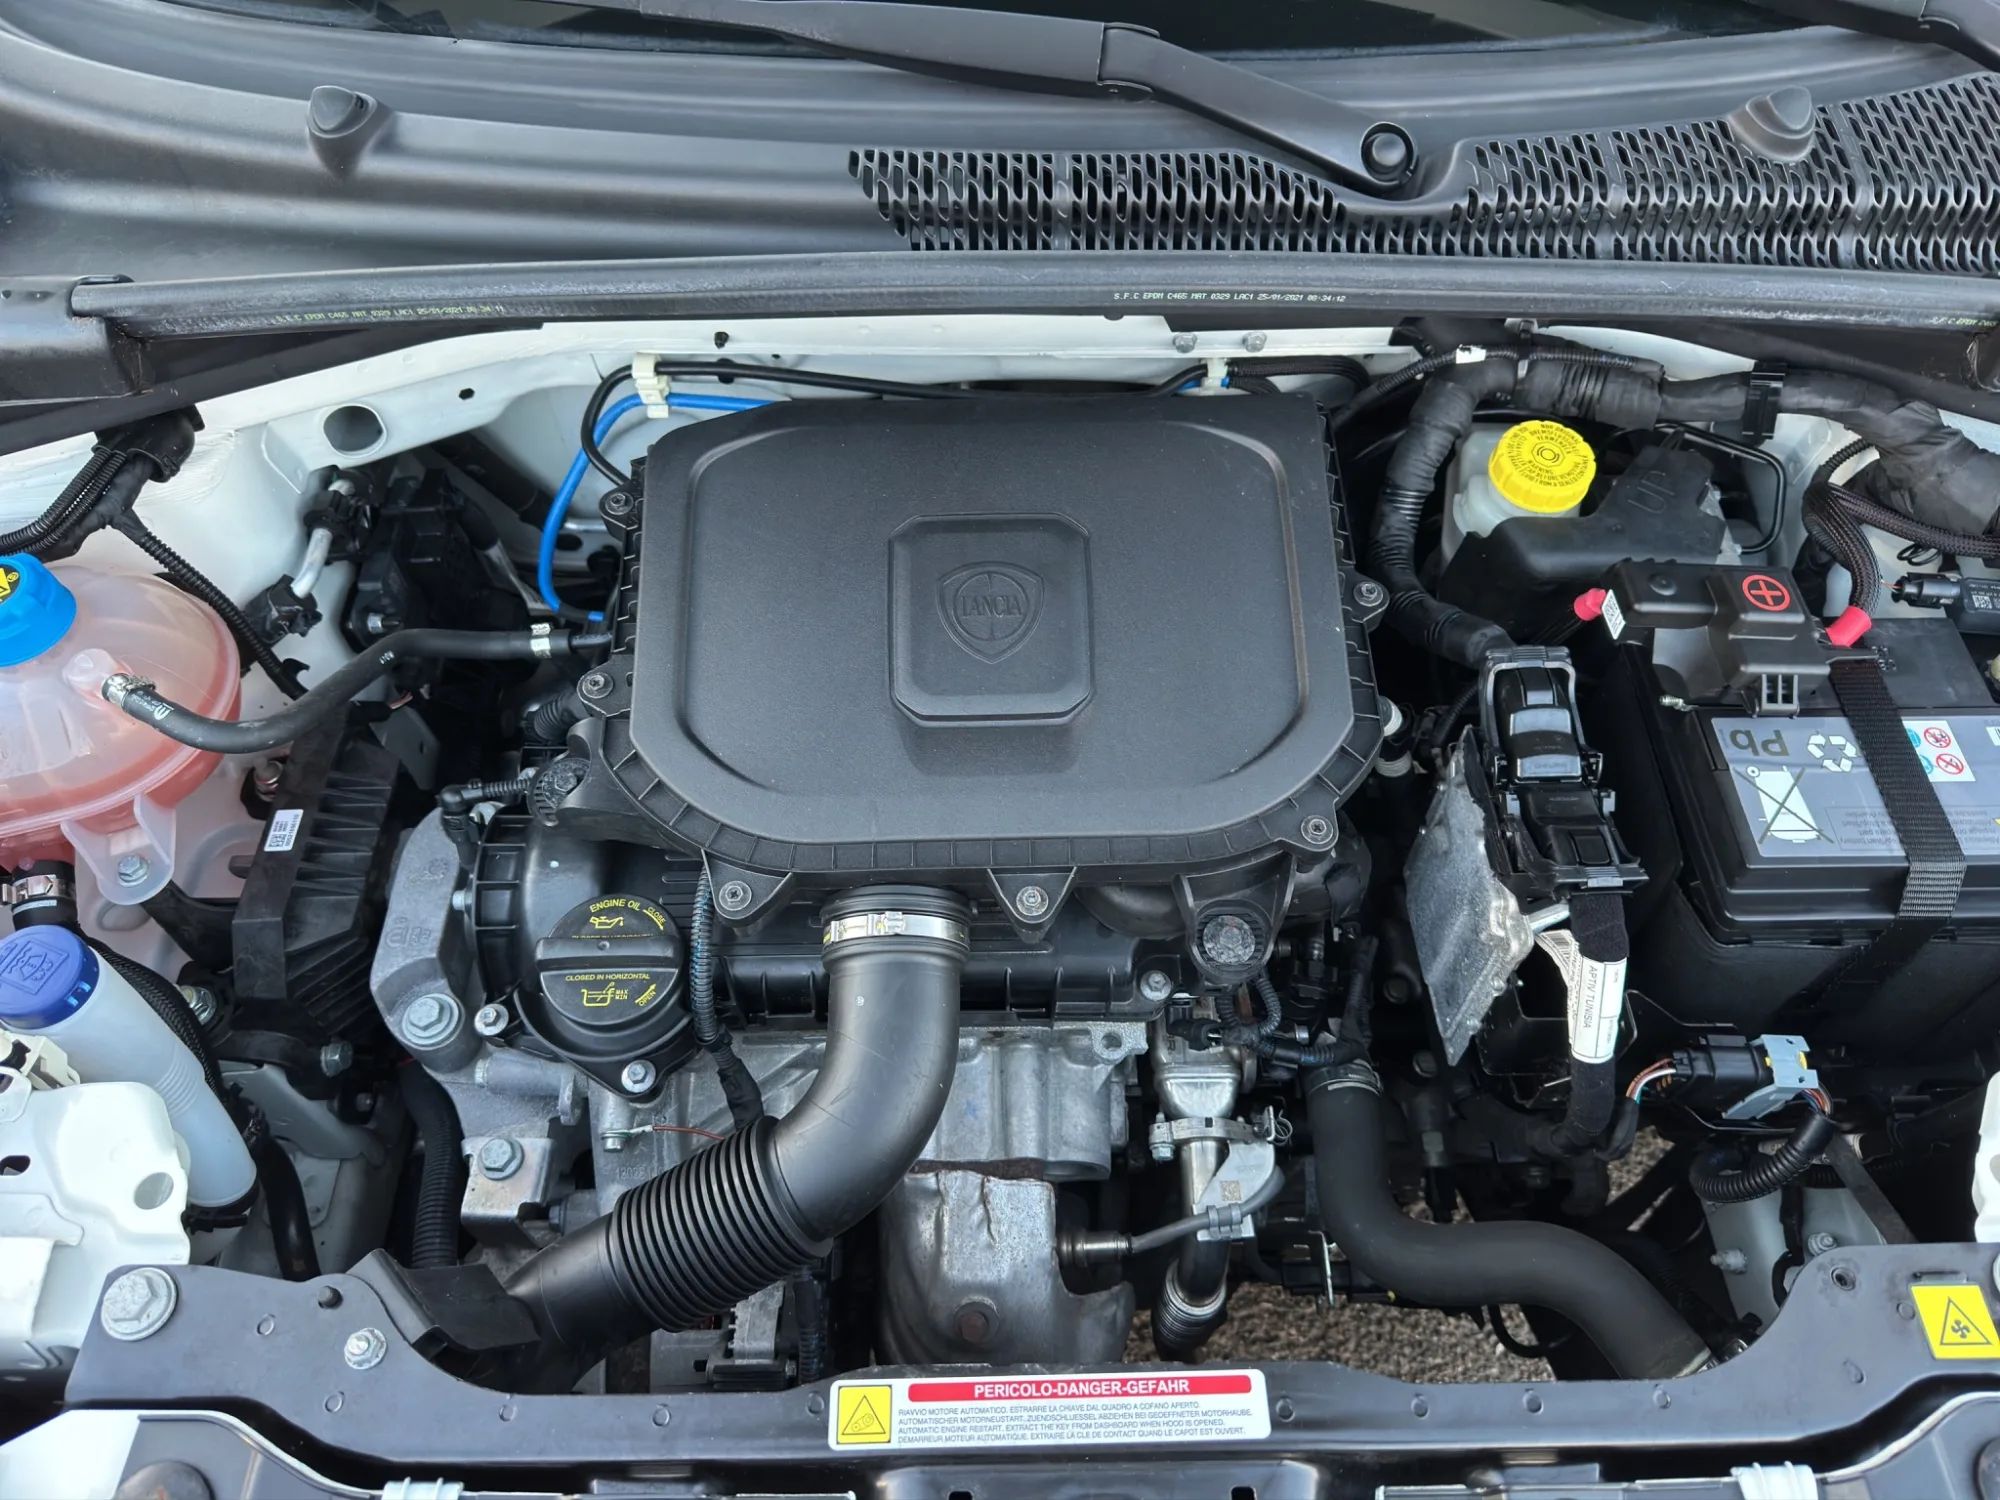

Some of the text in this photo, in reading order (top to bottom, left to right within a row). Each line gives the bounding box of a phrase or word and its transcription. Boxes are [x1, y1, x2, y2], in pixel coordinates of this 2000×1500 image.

[962, 596, 1023, 618] LANCIA
[1729, 729, 1790, 757] Pb
[590, 898, 640, 912] ENGINE OIL
[648, 906, 666, 925] CLOSE
[565, 974, 594, 982] CLOSED
[638, 990, 656, 1006] OPEN
[1584, 966, 1598, 1028] APTIV TUNISIA
[974, 1380, 1190, 1398] PERICOLO-DANGER-GEFAHR
[898, 1408, 927, 1416] RIAVVIO
[1059, 1404, 1084, 1412] CHIAVE
[1140, 1402, 1169, 1410] COFANO
[898, 1417, 958, 1425] AUTOMATISCHER
[1027, 1414, 1096, 1422] ZUENDSCHLUESSEL
[1098, 1412, 1133, 1420] ABZIEHEN
[1148, 1410, 1200, 1418] GEOEFFNETER
[898, 1426, 939, 1434] AUTOMATIC
[1072, 1422, 1092, 1430] FROM
[1094, 1421, 1138, 1429] DASHBOARD
[1140, 1420, 1160, 1428] WHEN
[898, 1435, 943, 1443] DEMARREUR
[944, 1434, 974, 1442] MOTEUR
[1030, 1432, 1064, 1440] EXTRAIRE
[1174, 1428, 1197, 1436] CAPOT
